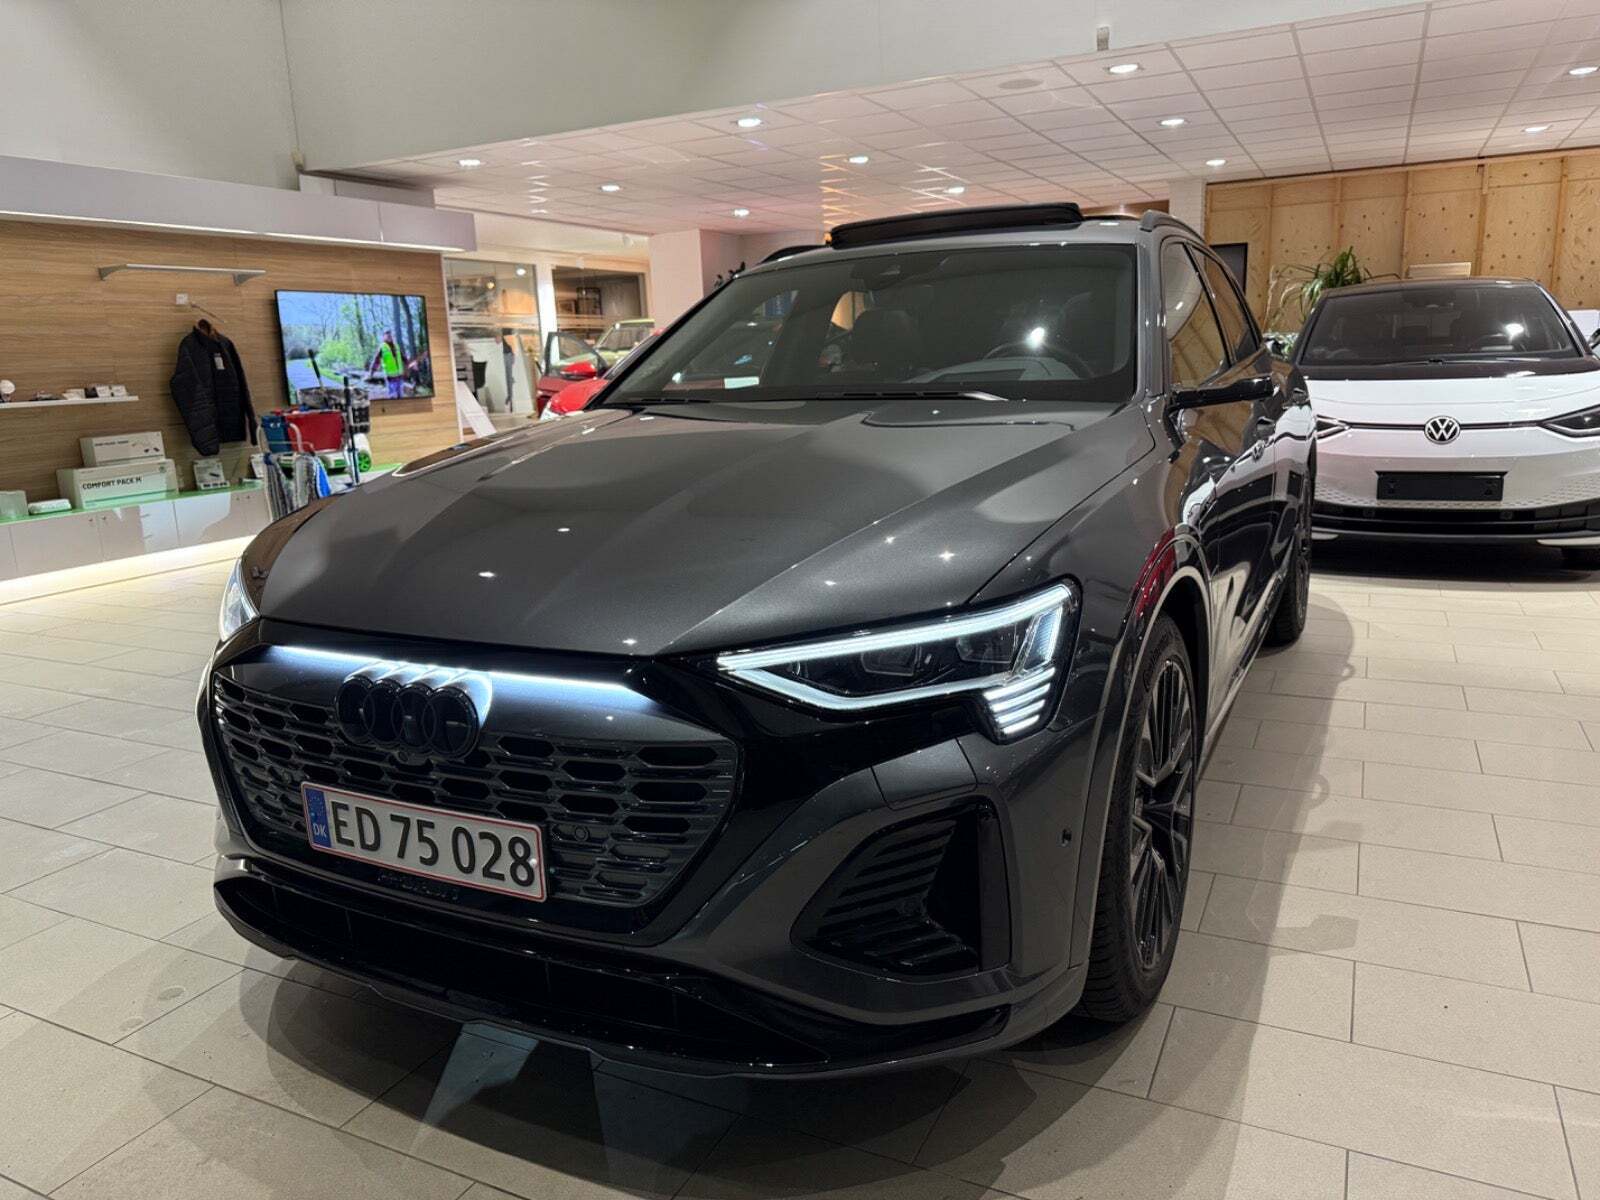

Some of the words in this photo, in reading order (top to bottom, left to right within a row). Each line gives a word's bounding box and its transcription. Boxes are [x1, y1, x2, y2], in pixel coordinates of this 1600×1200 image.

[82, 480, 116, 490] COMFORT
[116, 477, 134, 486] PACK
[312, 823, 327, 838] DK
[331, 801, 381, 852] ED
[390, 813, 439, 866] 75
[452, 826, 535, 887] 028
